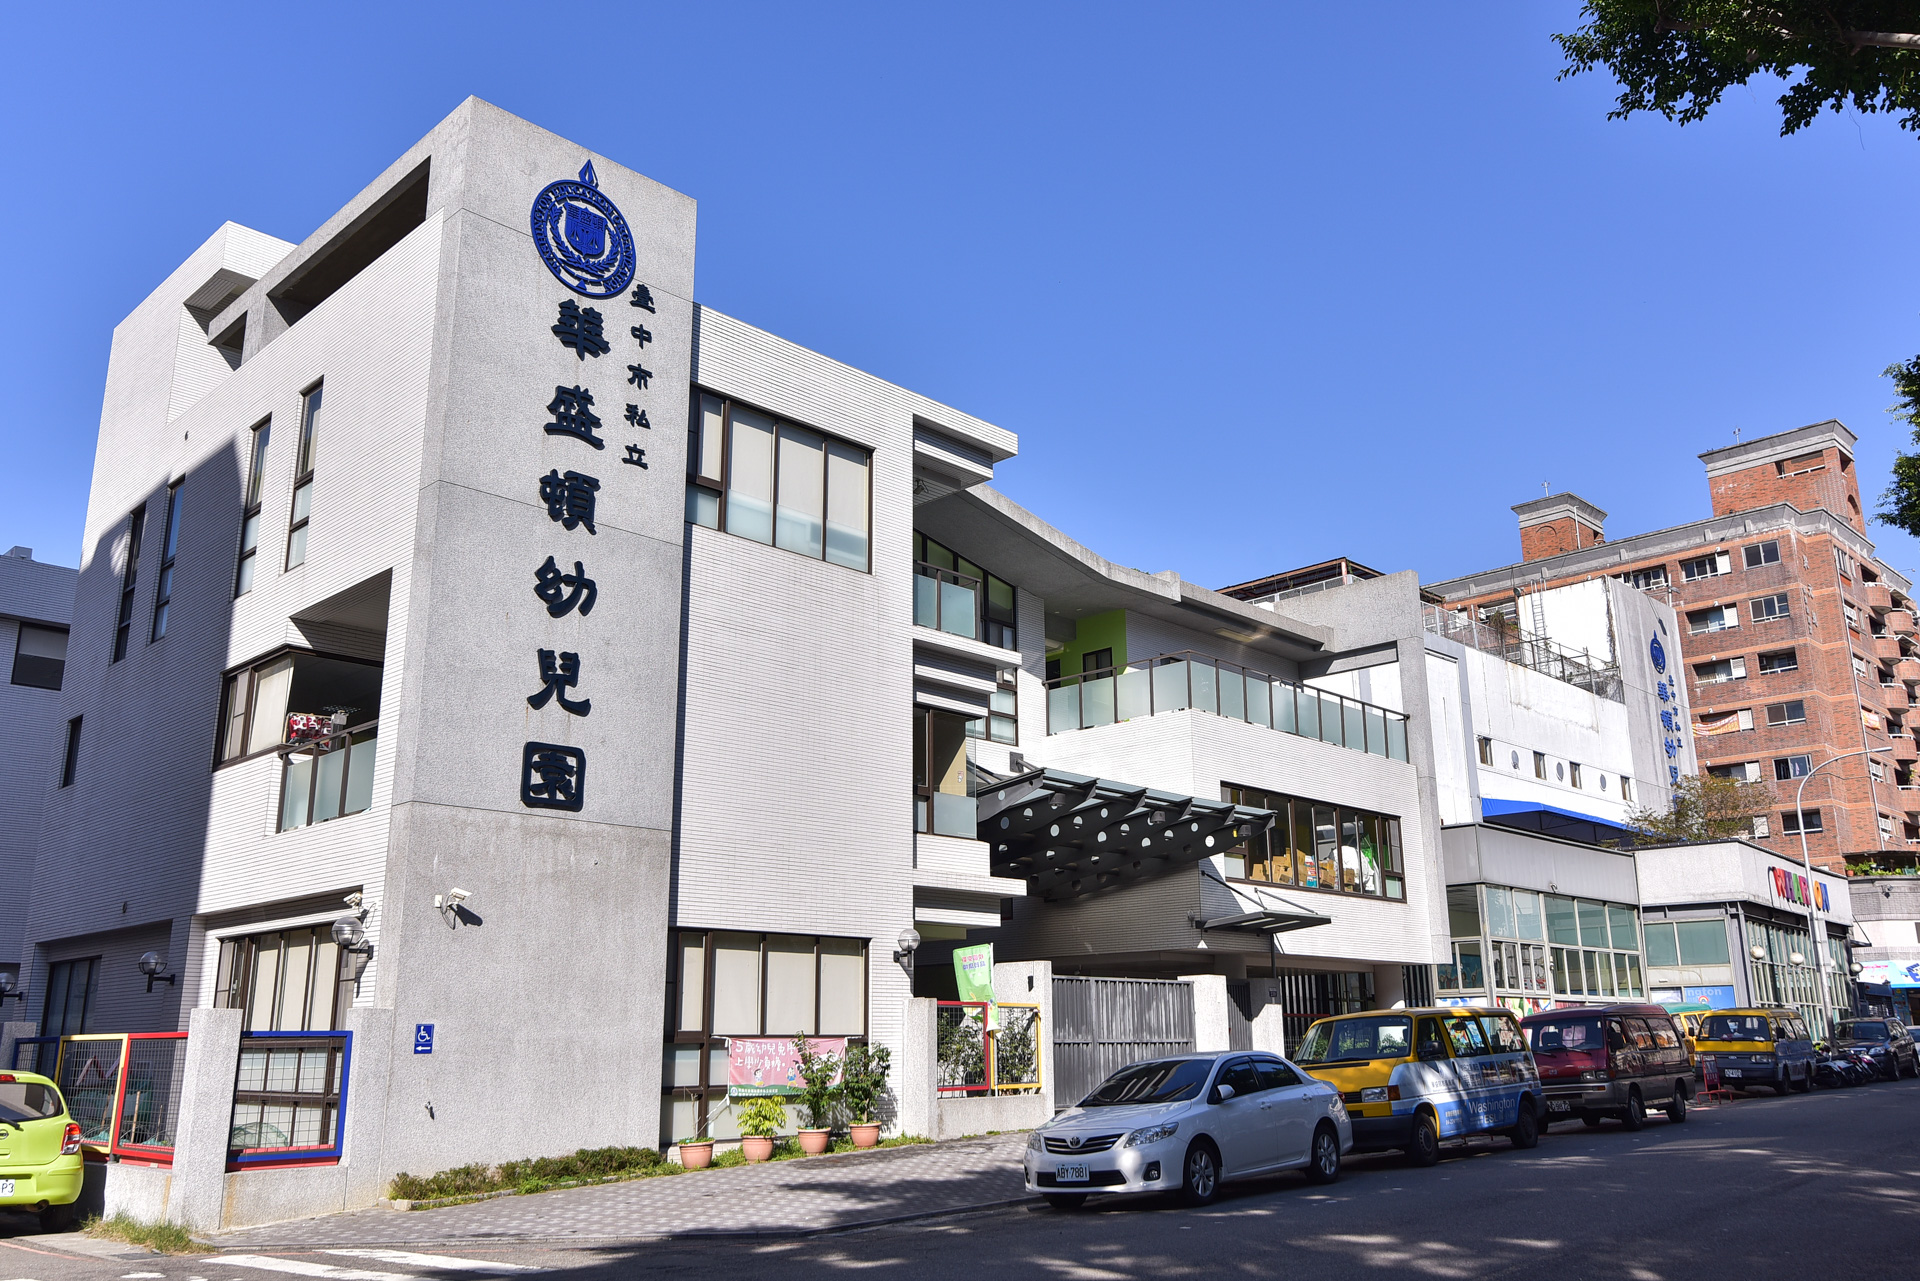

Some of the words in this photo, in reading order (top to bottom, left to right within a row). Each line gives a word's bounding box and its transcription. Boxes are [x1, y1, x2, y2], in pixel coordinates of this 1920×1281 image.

[621, 283, 656, 470] 臺中市私立
[520, 299, 611, 813] 華盛頓幼兒園
[1771, 866, 1830, 911] WHARON
[735, 1040, 799, 1056] 5歲幼兒免學
[1468, 1097, 1515, 1114] Washington
